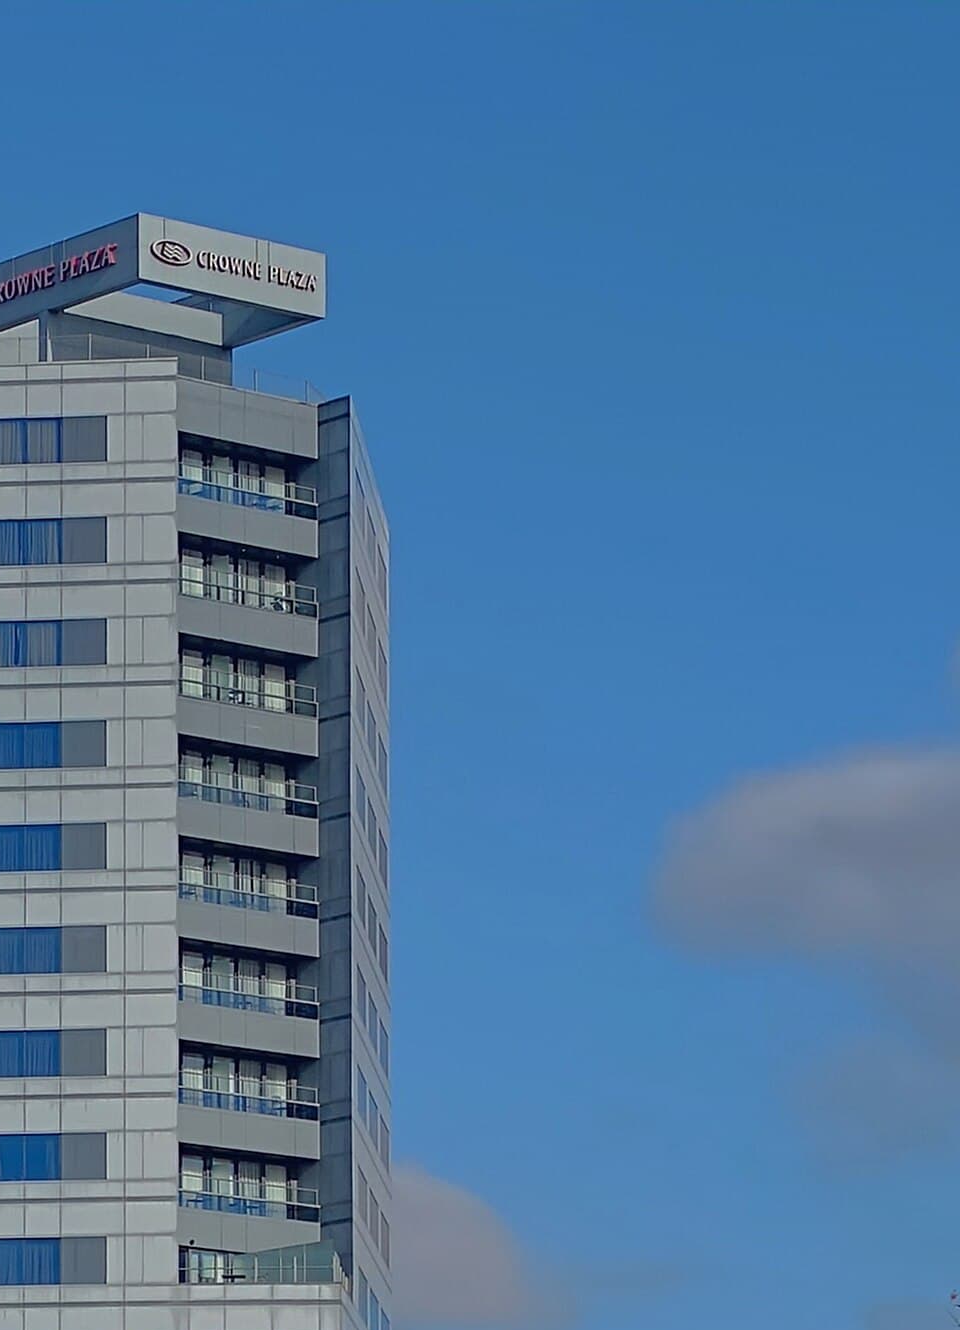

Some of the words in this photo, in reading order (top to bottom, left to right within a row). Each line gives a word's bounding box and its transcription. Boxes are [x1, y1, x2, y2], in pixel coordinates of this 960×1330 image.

[60, 244, 118, 281] PLAZA
[197, 250, 261, 281] CROWNE
[268, 265, 317, 292] PLAZA
